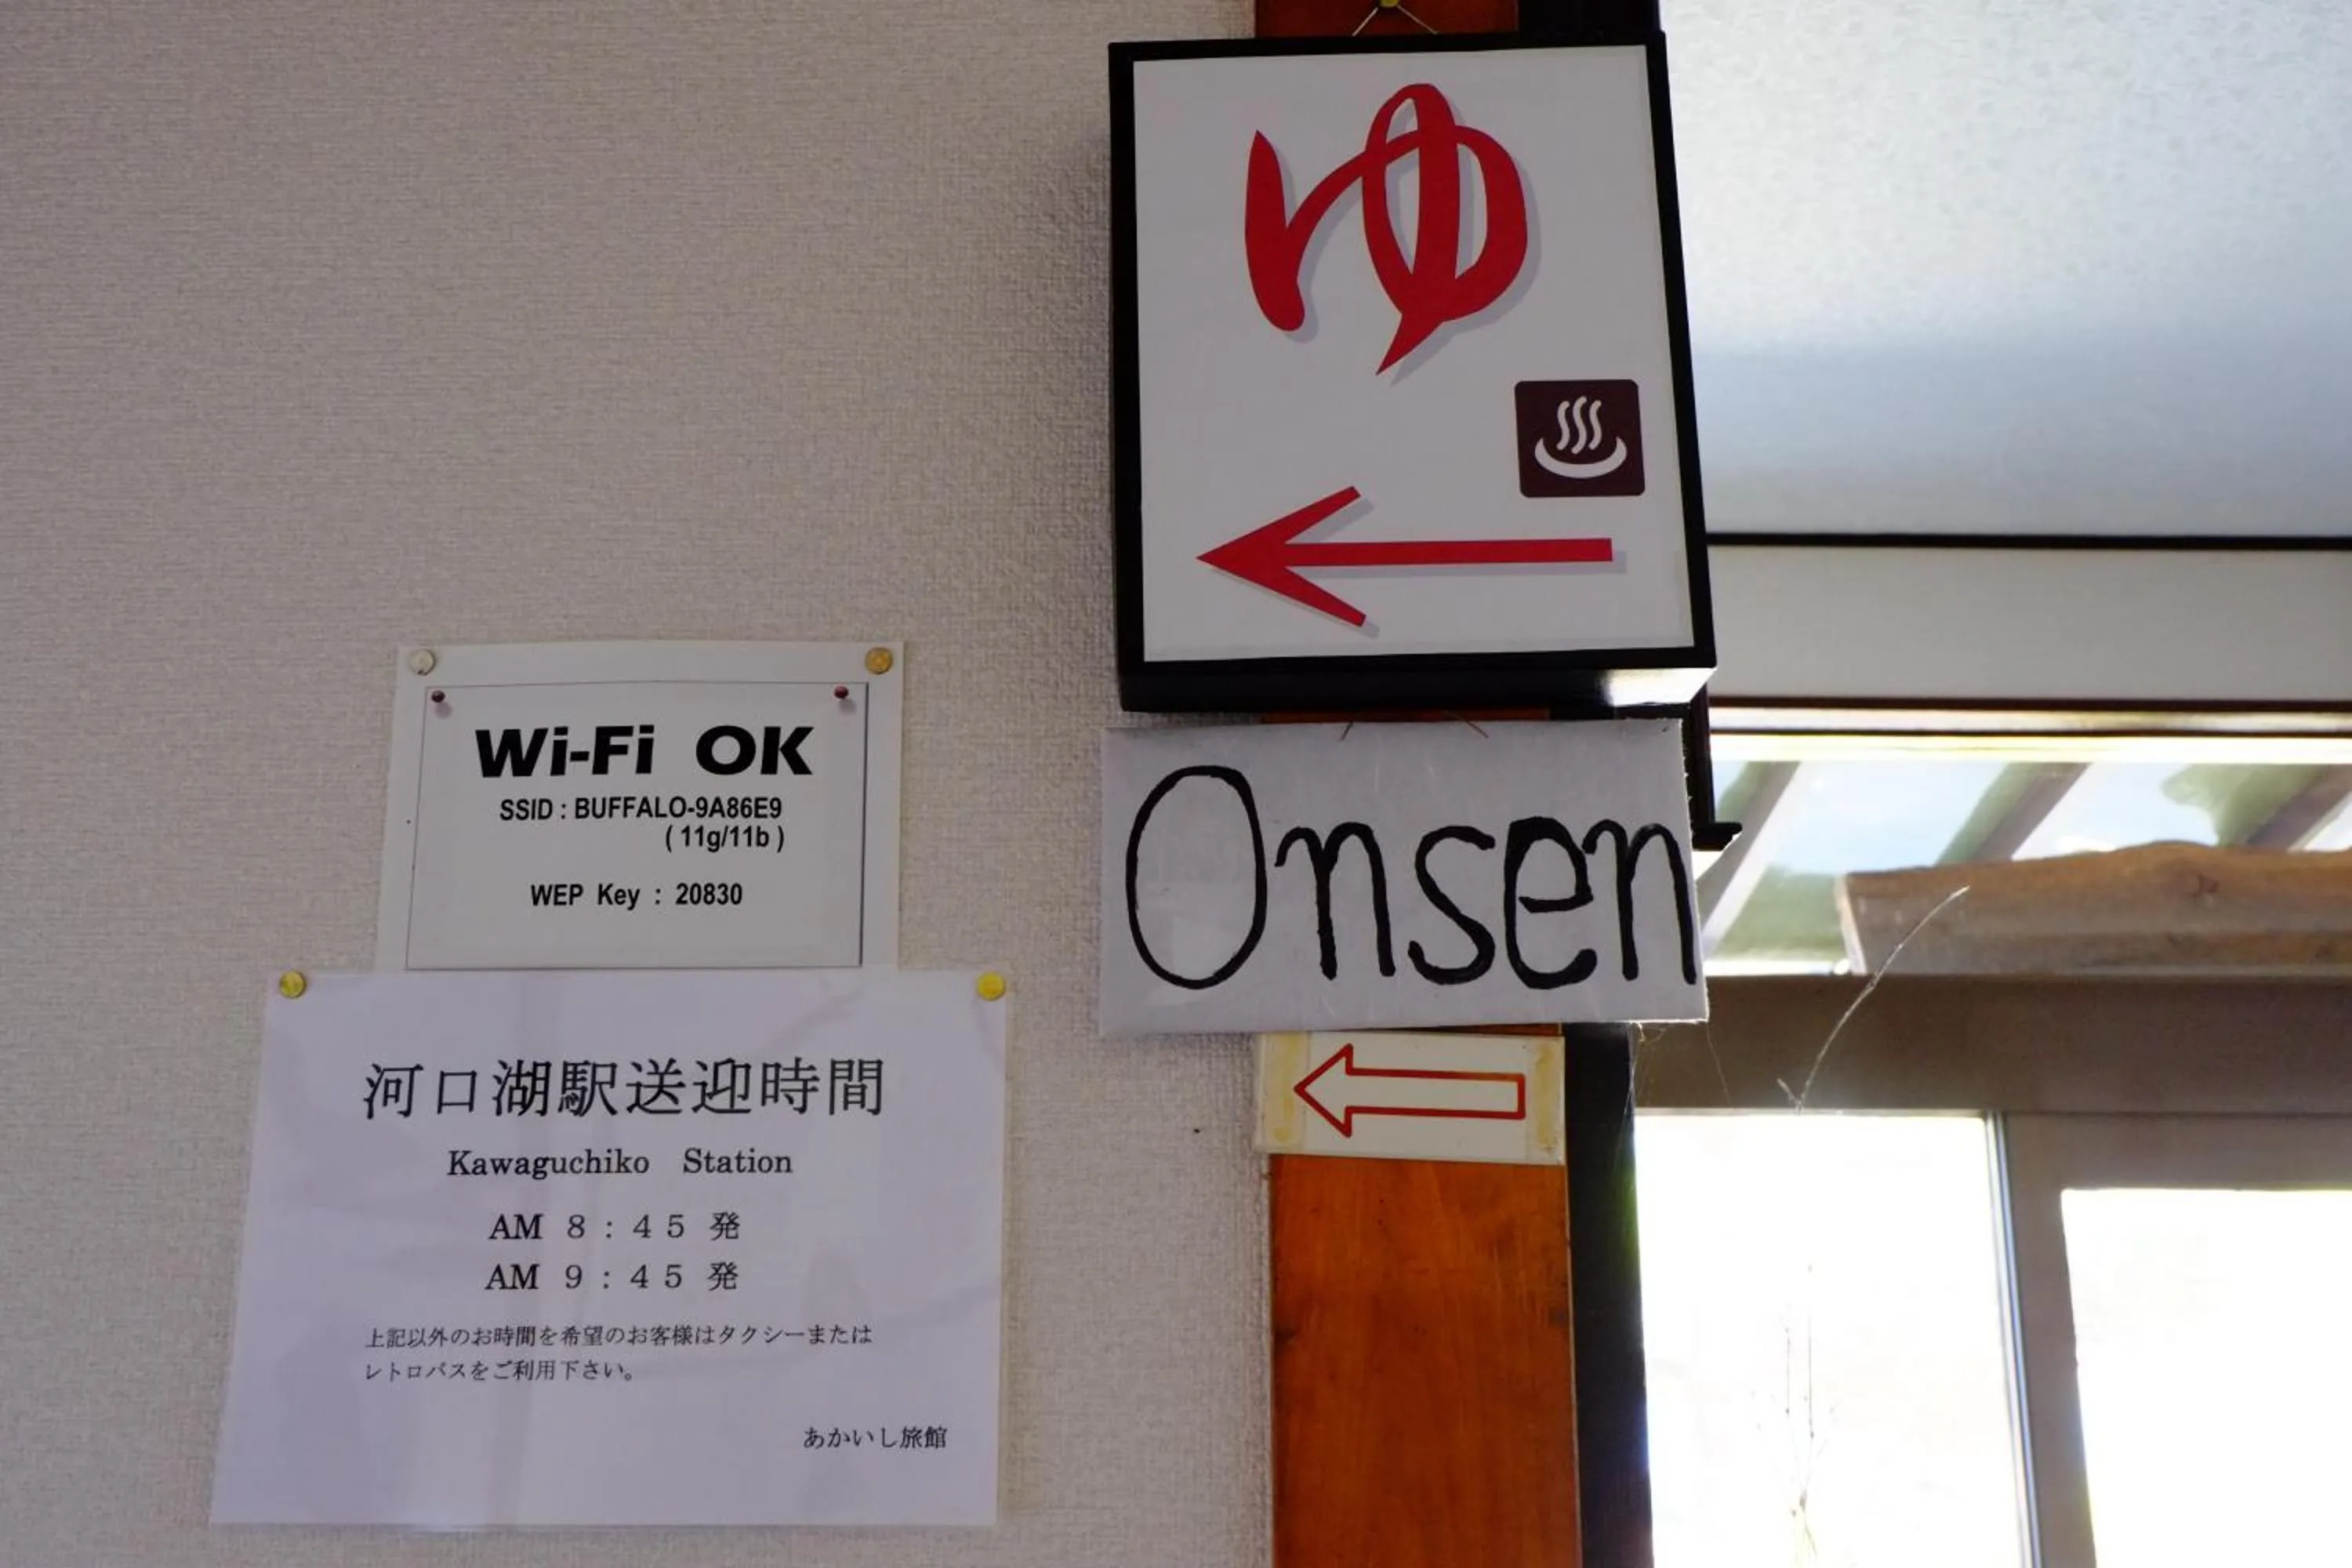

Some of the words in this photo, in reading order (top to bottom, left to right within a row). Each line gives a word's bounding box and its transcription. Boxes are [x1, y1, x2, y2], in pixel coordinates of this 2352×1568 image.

[1244, 83, 1528, 376] ゆ
[475, 724, 655, 779] Wi-Fi
[695, 724, 815, 775] OK
[575, 796, 782, 819] BUFFALO-9A86E9
[1125, 764, 1697, 990] Onsen
[531, 884, 584, 906] WEP
[597, 883, 641, 911] Key
[675, 882, 742, 906] 20830
[363, 1057, 884, 1120] 河口湖駅送迎時間
[447, 1148, 649, 1181] Kawaguchiko
[683, 1147, 791, 1174] Station
[488, 1214, 543, 1240] AM
[485, 1263, 540, 1290] AM
[365, 1324, 873, 1348] 上記以外のお時間を希望のお客様はタクシーまたは
[804, 1426, 947, 1449] あかいし旅館
